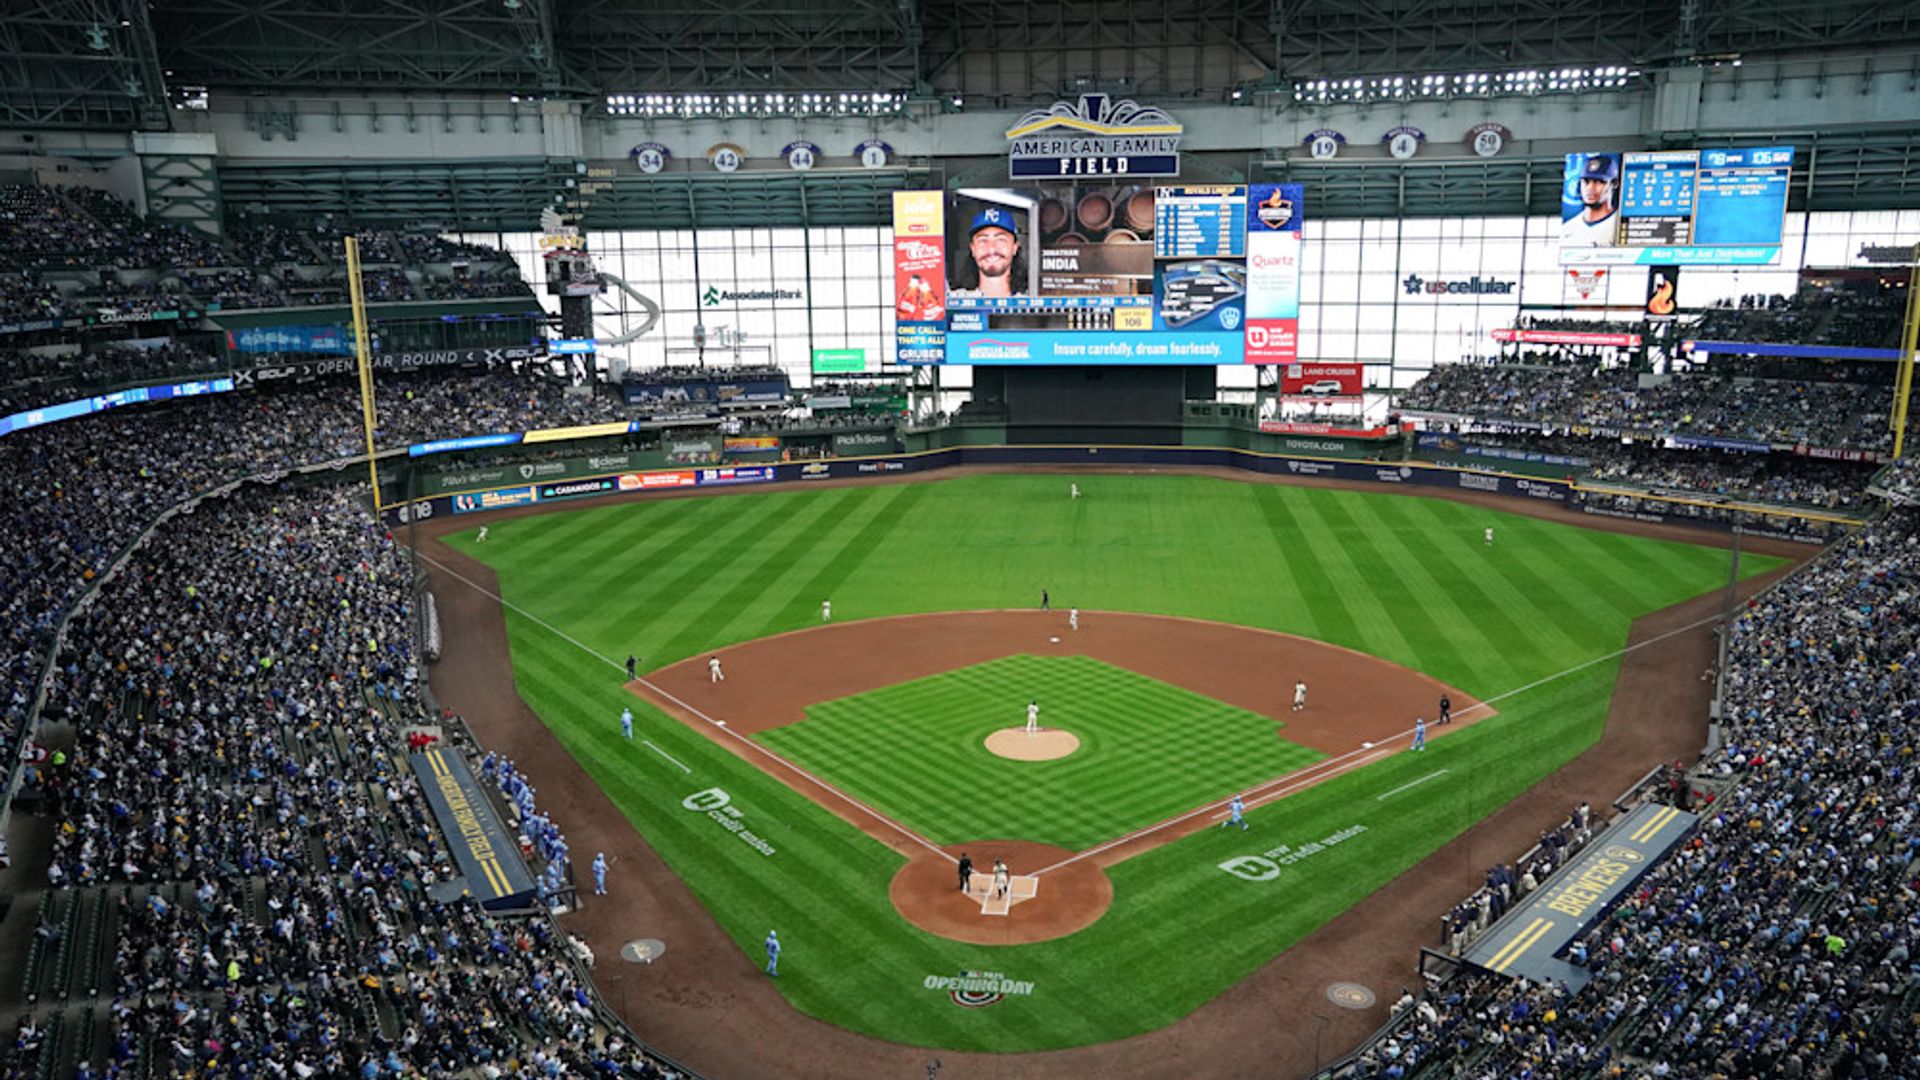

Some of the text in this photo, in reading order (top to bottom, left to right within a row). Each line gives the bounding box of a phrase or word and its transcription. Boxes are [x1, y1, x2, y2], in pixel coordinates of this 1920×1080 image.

[1012, 138, 1177, 155] AMERICAN FAMILY
[1316, 142, 1333, 155] 19
[1397, 139, 1408, 153] 4
[641, 154, 661, 169] 34
[717, 154, 735, 168] 42
[793, 153, 810, 167] 44
[870, 152, 878, 165] 1
[1060, 157, 1128, 174] FIELD
[1042, 258, 1079, 270] INDIA
[1252, 254, 1294, 268] Quartz
[1425, 276, 1516, 295] uscellular
[720, 289, 780, 301] Associated
[100, 311, 152, 323] CASAMIGOS
[898, 326, 915, 335] ONE
[899, 349, 944, 359] GRUBER
[1054, 342, 1222, 357] Insure carefully, dream fearlessly.
[316, 360, 354, 375] OPEN
[401, 351, 459, 366] ROUND
[1303, 367, 1357, 376] LAND CRUISER
[1286, 440, 1344, 451] TOYOTA.COM
[555, 481, 602, 497] CASAMIGOS
[1548, 858, 1630, 917] BREWERS
[924, 975, 1035, 995] OPENING DAY
